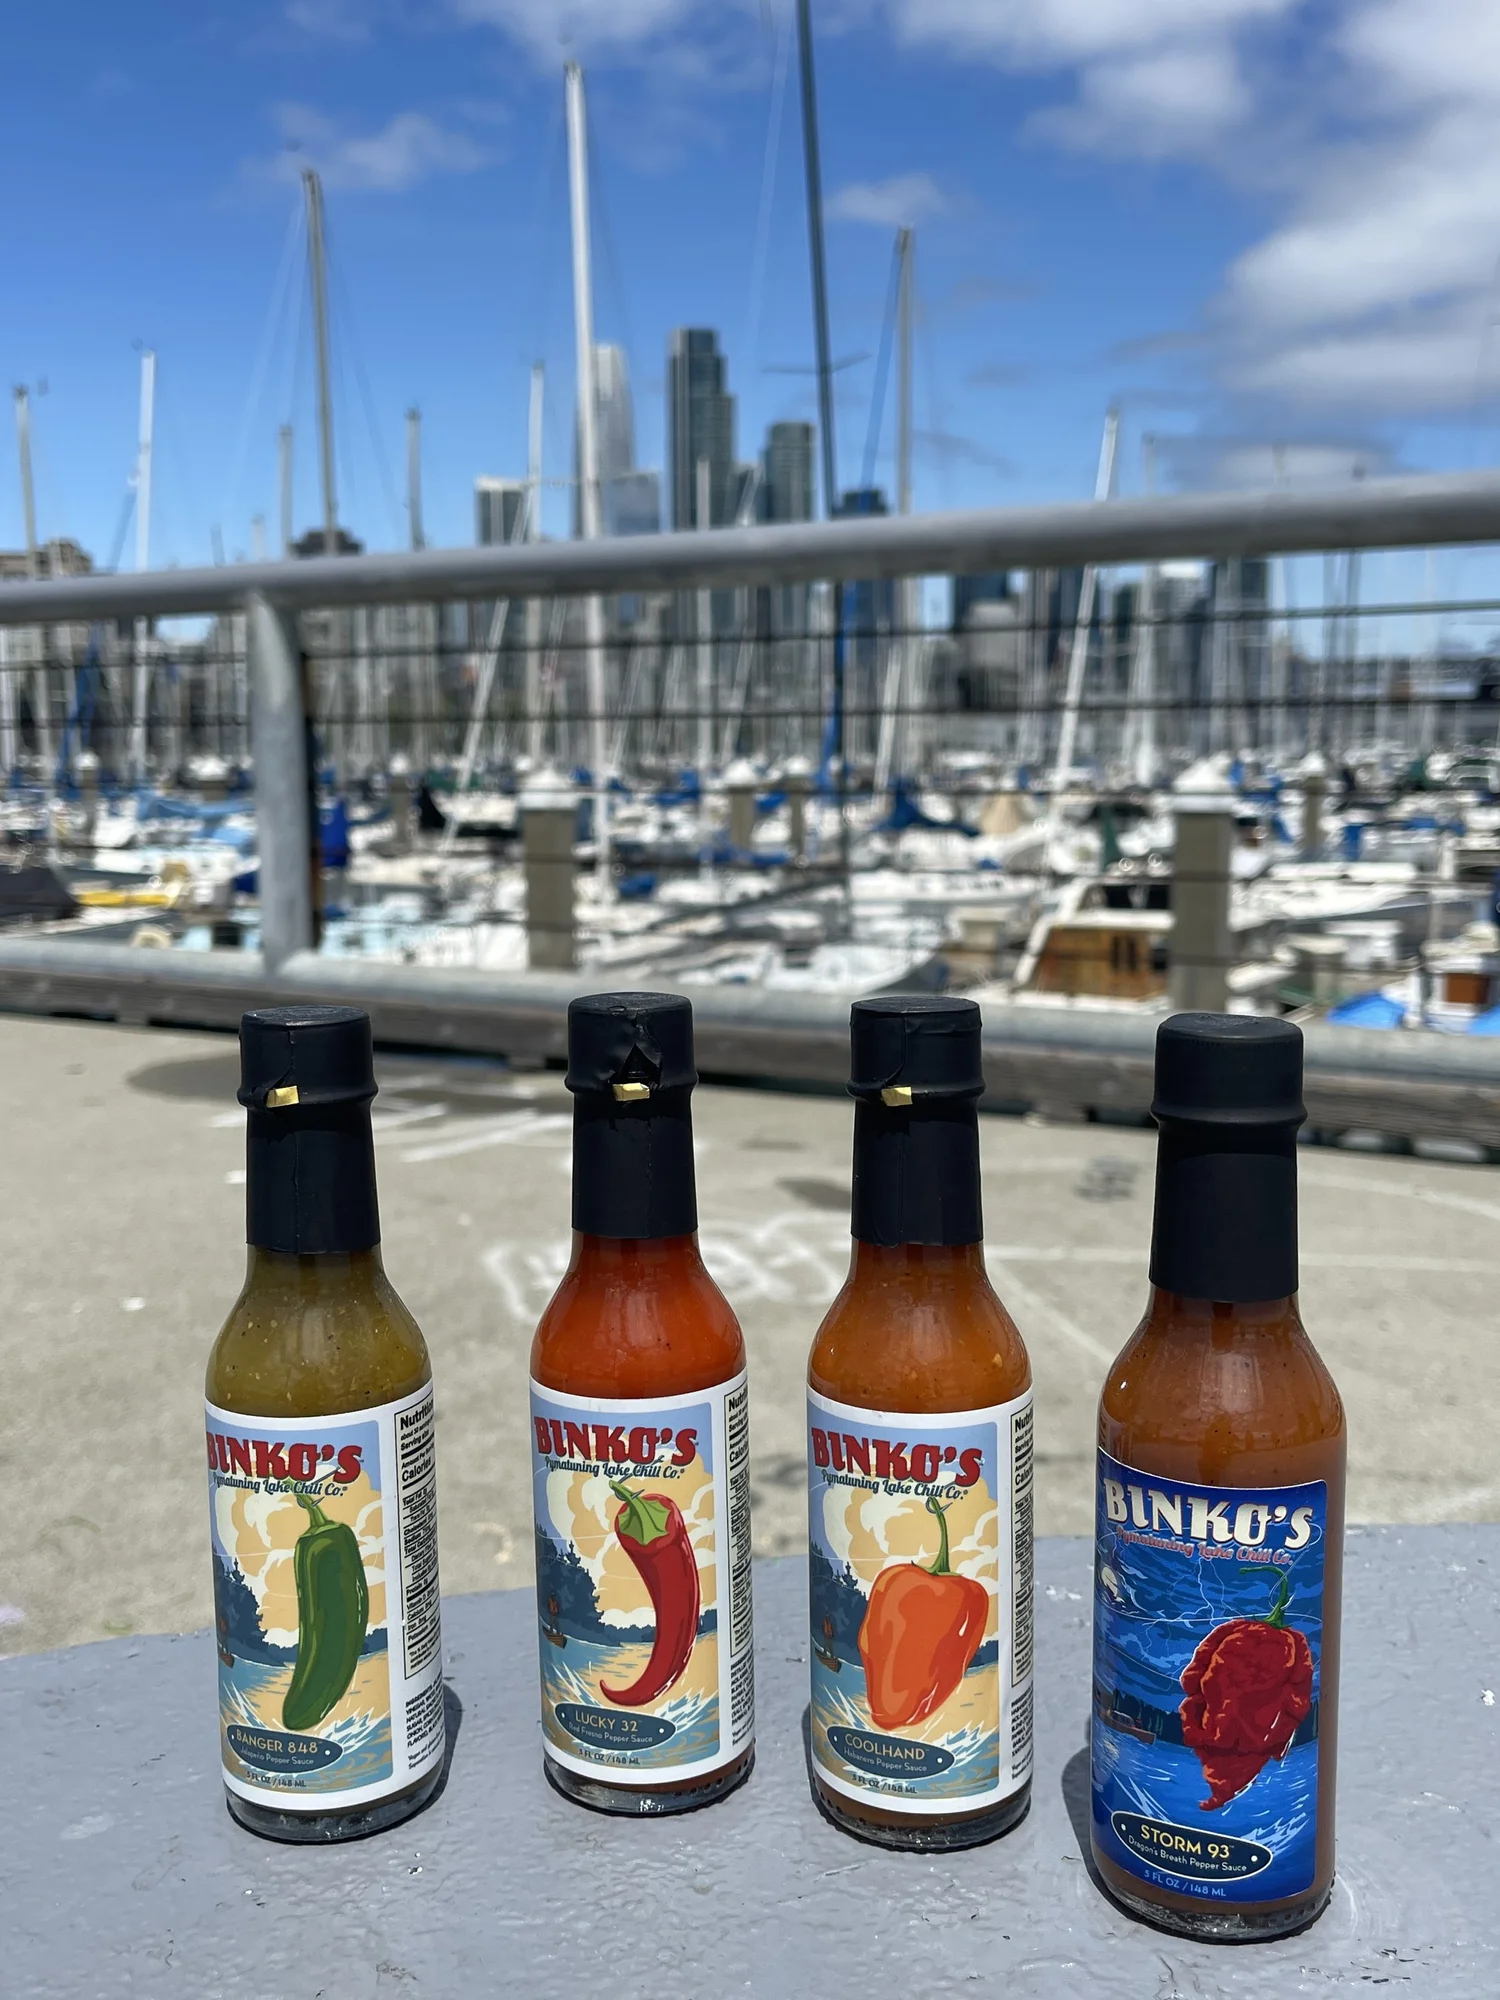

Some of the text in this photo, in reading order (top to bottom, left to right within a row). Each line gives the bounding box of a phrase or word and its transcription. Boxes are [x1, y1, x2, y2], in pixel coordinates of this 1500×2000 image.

[533, 1416, 698, 1467] BINKO'S
[206, 1431, 362, 1484] BINKO'S
[402, 1456, 431, 1482] Calories
[544, 1455, 600, 1477] Pymatuning
[602, 1462, 630, 1477] Lake
[632, 1463, 660, 1478] Chili
[811, 1427, 983, 1487] BINKO'S
[262, 1478, 291, 1495] Lake
[293, 1480, 324, 1496] Chili
[821, 1469, 879, 1495] Pymatuning
[882, 1479, 911, 1496] Lake
[914, 1482, 944, 1498] Chili
[1103, 1478, 1313, 1550] BINKO'S
[1116, 1525, 1195, 1558] Pymatuning
[1199, 1541, 1233, 1562] Lake
[1236, 1545, 1271, 1564] Chili
[568, 1722, 653, 1743] Red Fresno Pepper Sauce
[575, 1710, 638, 1732] LUCKY 32
[236, 1728, 318, 1754] BANGER 848
[844, 1733, 926, 1760] COOLHAND
[265, 1753, 290, 1764] Pepper
[291, 1756, 314, 1765] Sauce
[584, 1749, 592, 1757] FL
[594, 1752, 605, 1761] OZ
[612, 1755, 627, 1764] 148
[628, 1756, 641, 1765] ML
[844, 1747, 928, 1772] Habanero Pepper Sauce
[246, 1771, 251, 1779] 5
[251, 1773, 259, 1781] FL
[261, 1775, 271, 1784] OZ
[294, 1779, 307, 1787] ML
[858, 1775, 866, 1783] FL
[869, 1779, 880, 1788] OZ
[887, 1782, 903, 1793] 148
[905, 1786, 917, 1794] ML
[1128, 1835, 1247, 1872] Dragon's Breath Pepper Sauce
[1140, 1824, 1230, 1858] STORM 93
[1144, 1869, 1150, 1878] 5
[1152, 1872, 1163, 1884] FL
[1167, 1877, 1180, 1889] OZ
[1190, 1883, 1209, 1895] 148
[1211, 1887, 1227, 1898] ML
